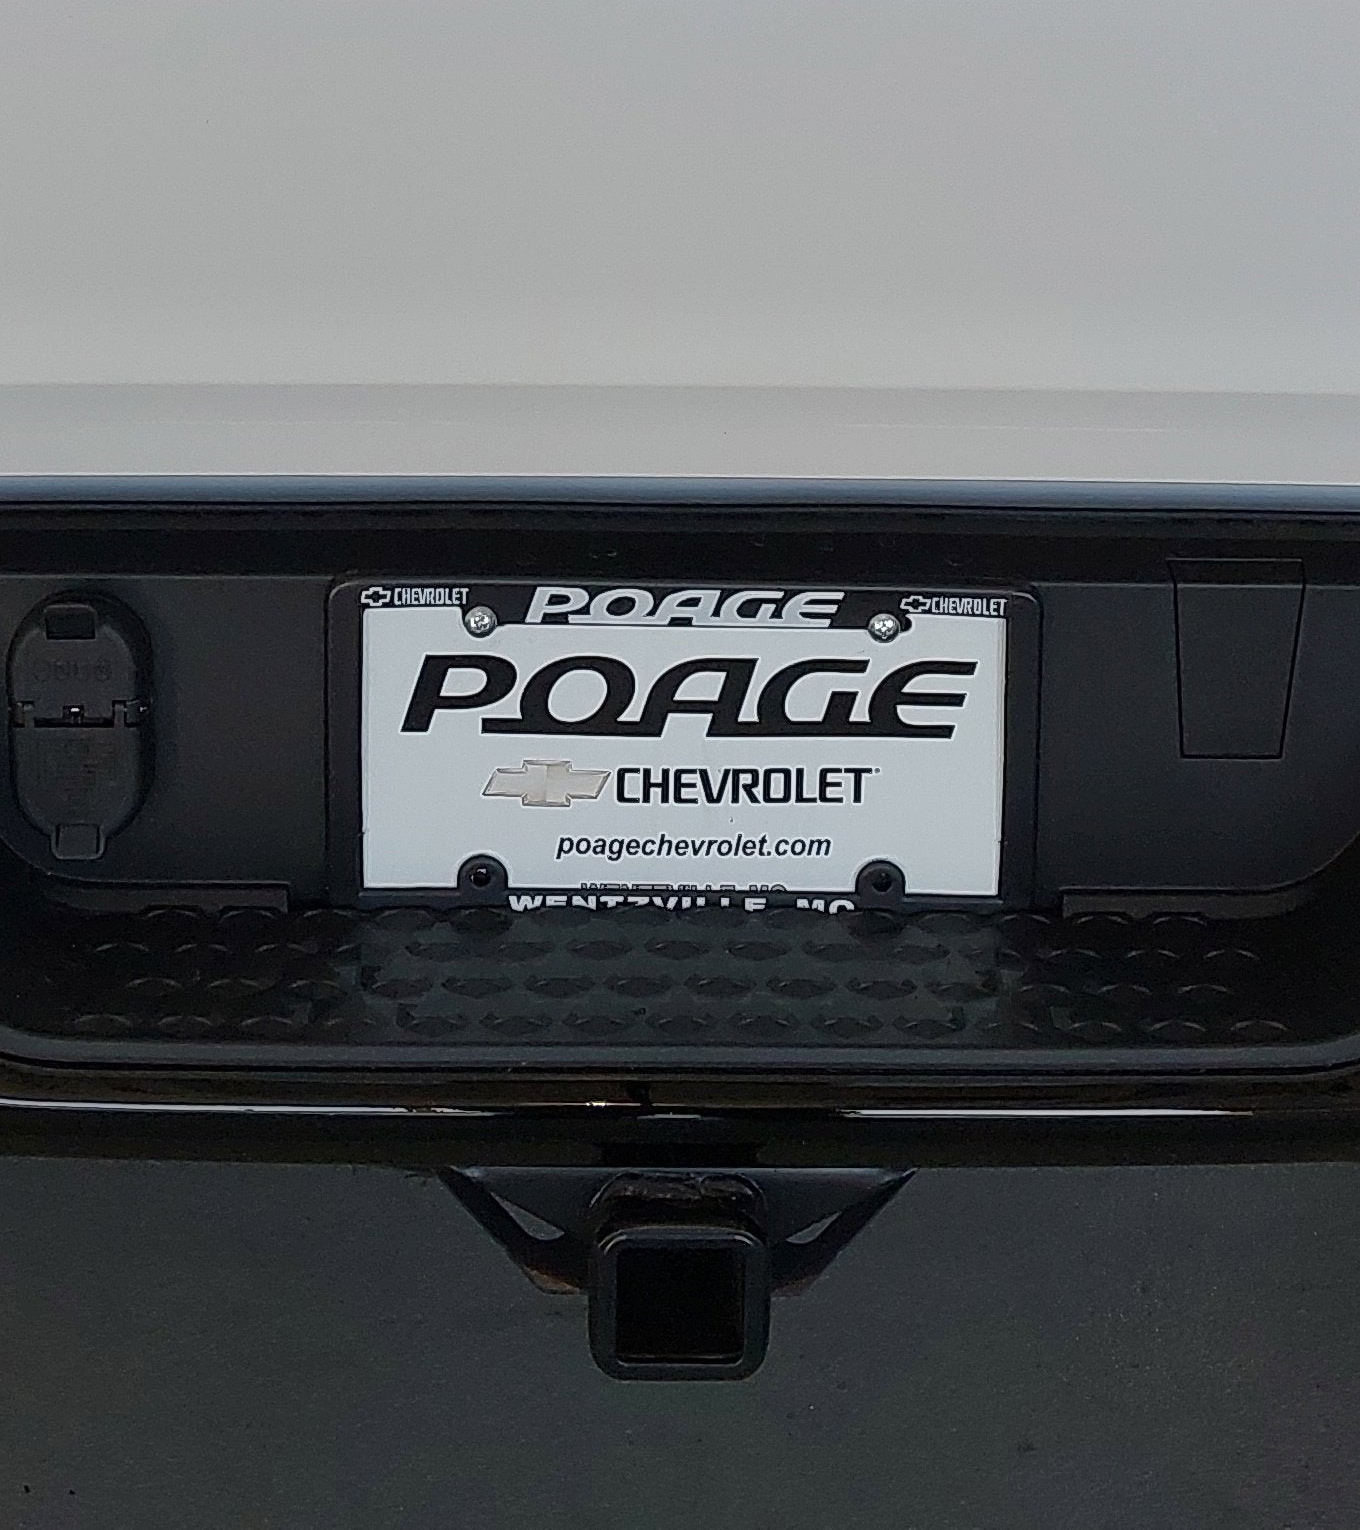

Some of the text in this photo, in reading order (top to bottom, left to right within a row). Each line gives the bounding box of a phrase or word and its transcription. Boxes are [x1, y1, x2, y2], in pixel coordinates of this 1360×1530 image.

[393, 586, 470, 606] CHEVROLET
[524, 586, 846, 628] POAGE
[930, 596, 1008, 617] CHEVROLET
[400, 653, 979, 739] POAGE
[615, 767, 873, 804] CHEVROLET
[556, 832, 832, 861] poagechevrolet.com
